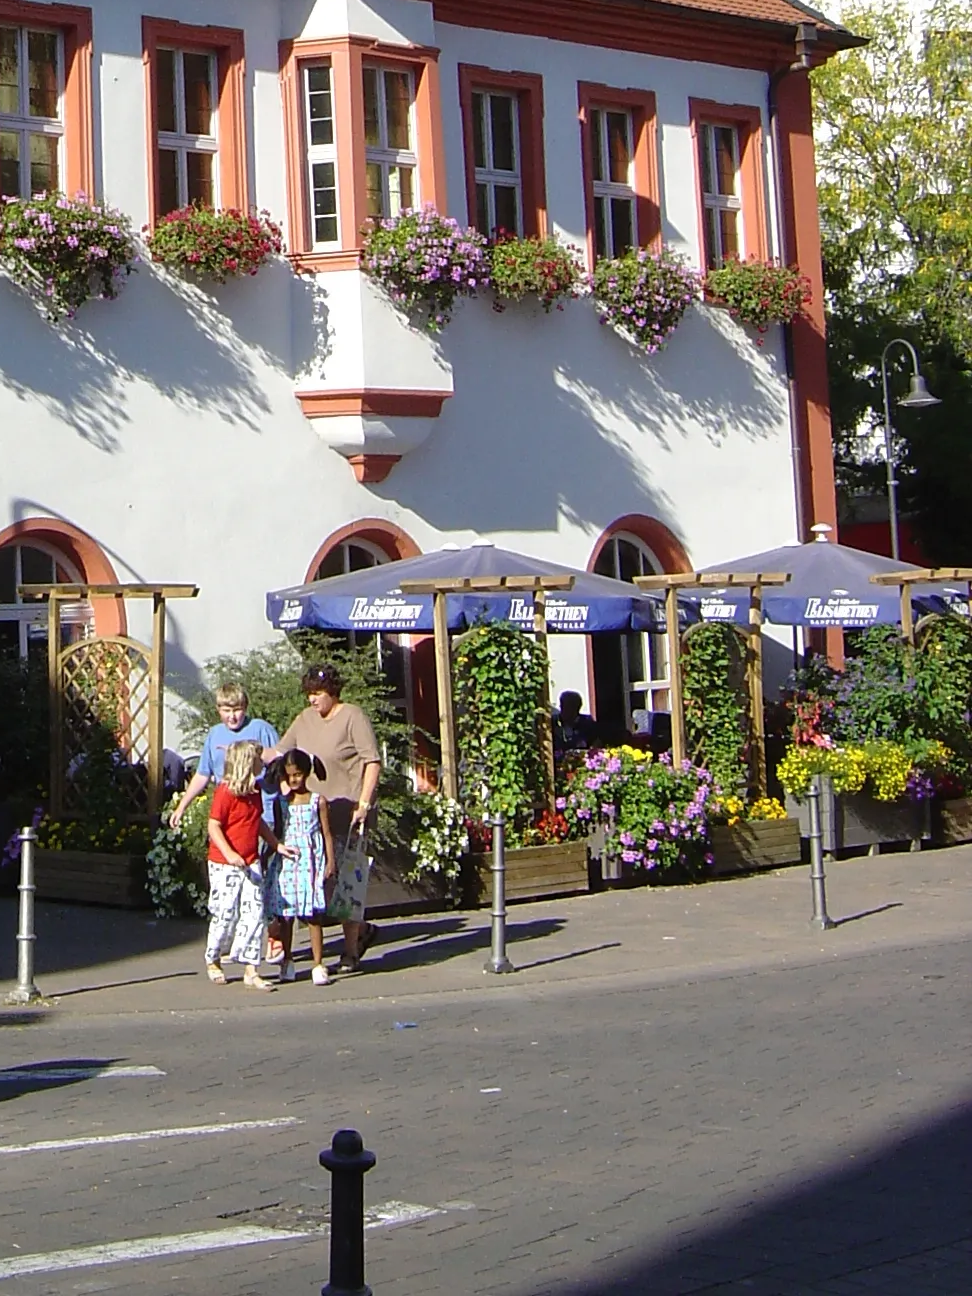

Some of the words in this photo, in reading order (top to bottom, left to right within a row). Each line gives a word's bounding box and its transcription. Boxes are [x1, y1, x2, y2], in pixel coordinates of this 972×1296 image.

[348, 597, 424, 621] ELISABETHEN
[508, 598, 589, 621] ELIBETHEN
[804, 597, 880, 619] ELISABETHEN
